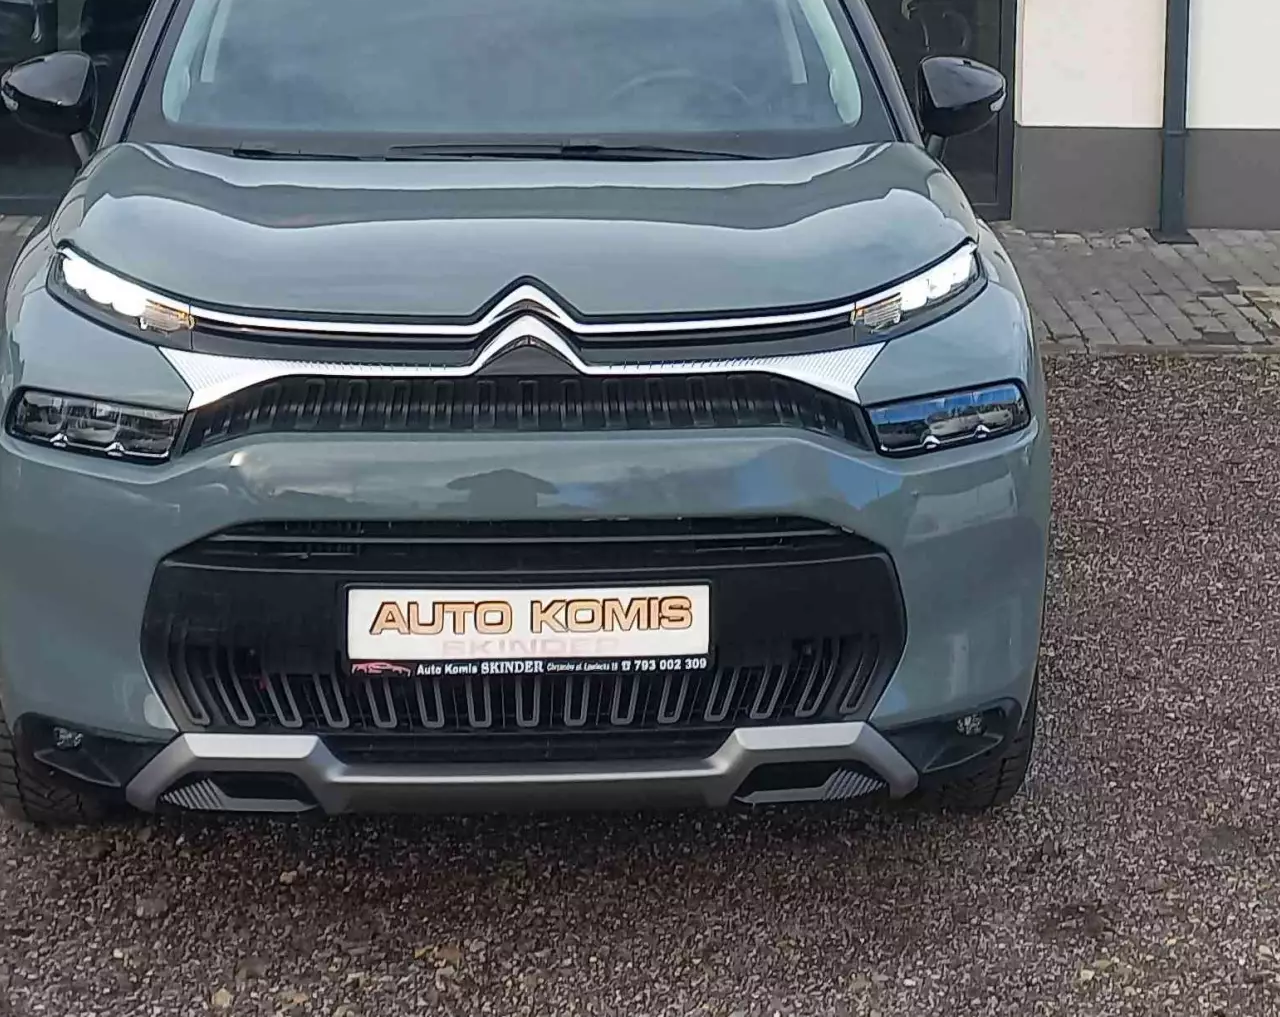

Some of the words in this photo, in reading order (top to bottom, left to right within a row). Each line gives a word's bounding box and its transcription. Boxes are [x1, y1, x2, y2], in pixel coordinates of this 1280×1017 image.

[369, 601, 512, 635] AUTO
[529, 596, 693, 634] KOMIS
[416, 663, 441, 676] Auto
[444, 663, 478, 675] Komis
[481, 660, 544, 674] SKINDER
[634, 660, 656, 671] 793
[660, 659, 681, 671] 002
[685, 658, 707, 670] 309
